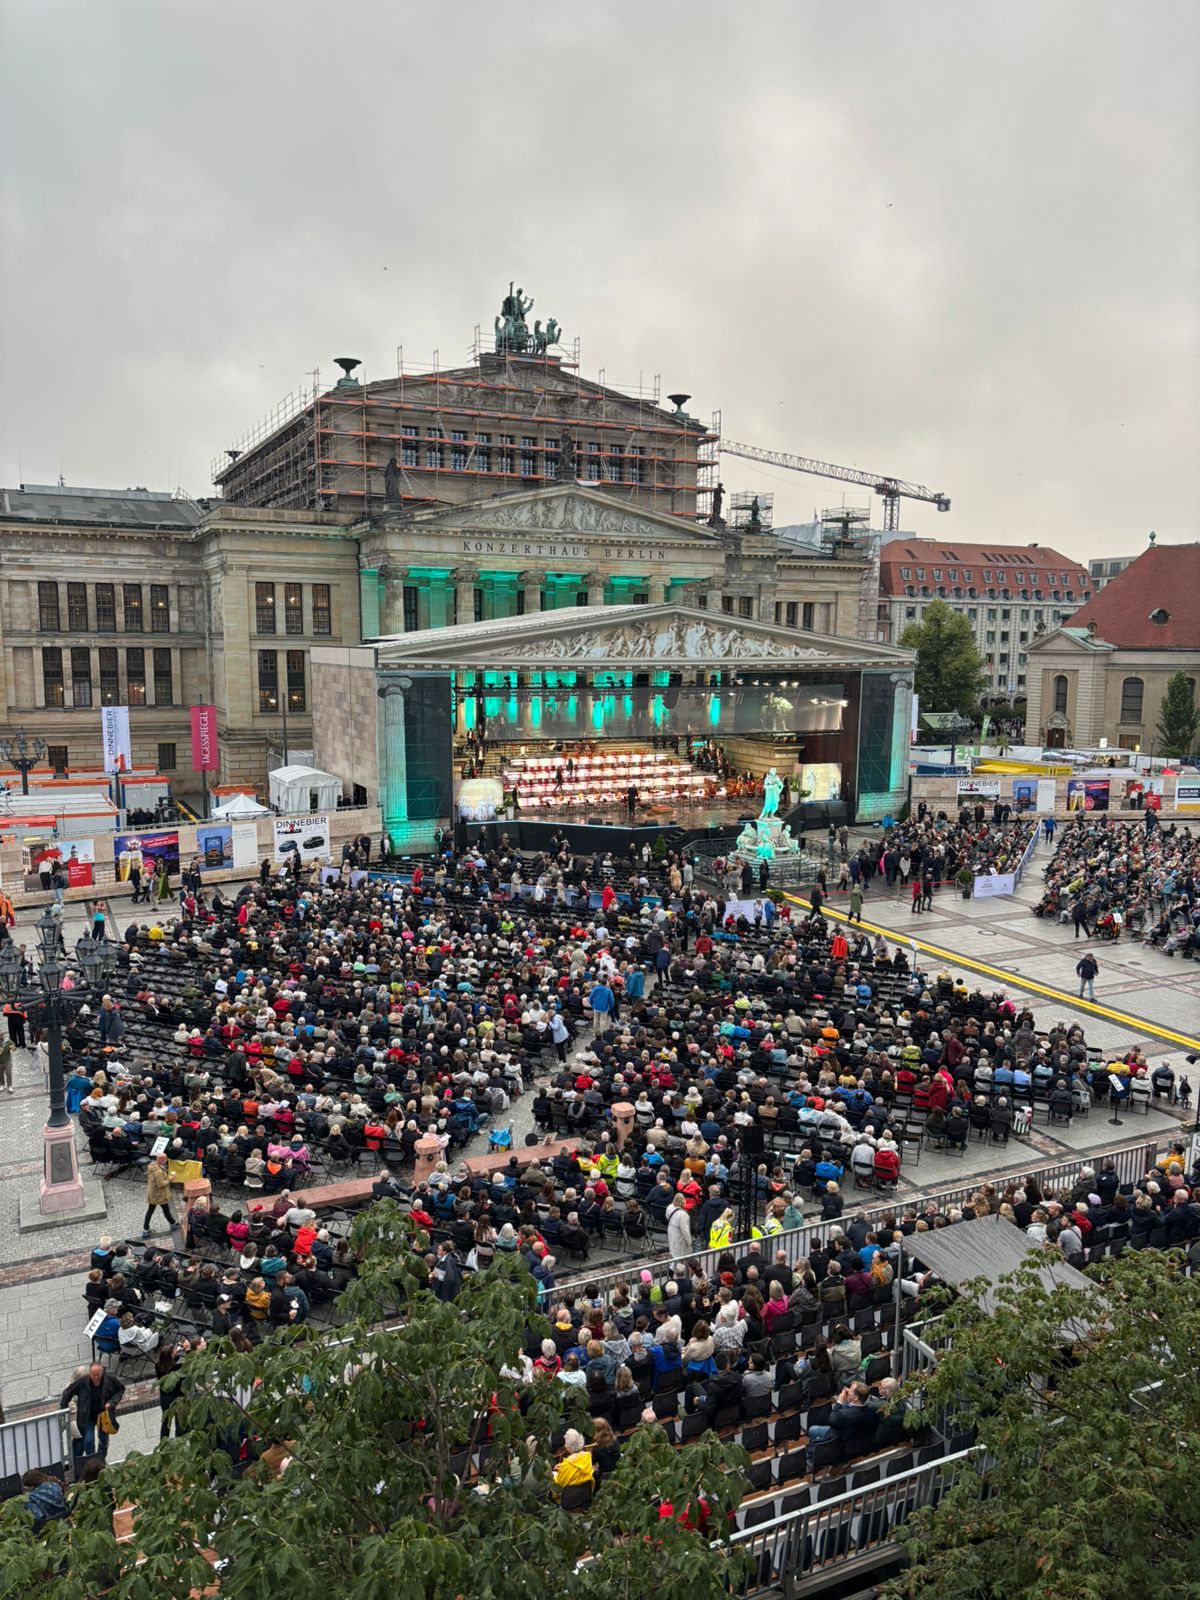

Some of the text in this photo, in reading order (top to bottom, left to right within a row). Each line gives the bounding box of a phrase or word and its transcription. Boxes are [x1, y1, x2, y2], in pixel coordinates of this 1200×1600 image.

[463, 541, 665, 560] KONZERTHAUS BERLIN
[106, 710, 115, 756] DINNEBIER
[200, 711, 210, 765] TAGESSPIEGEL
[276, 817, 327, 828] DINNEBIER
